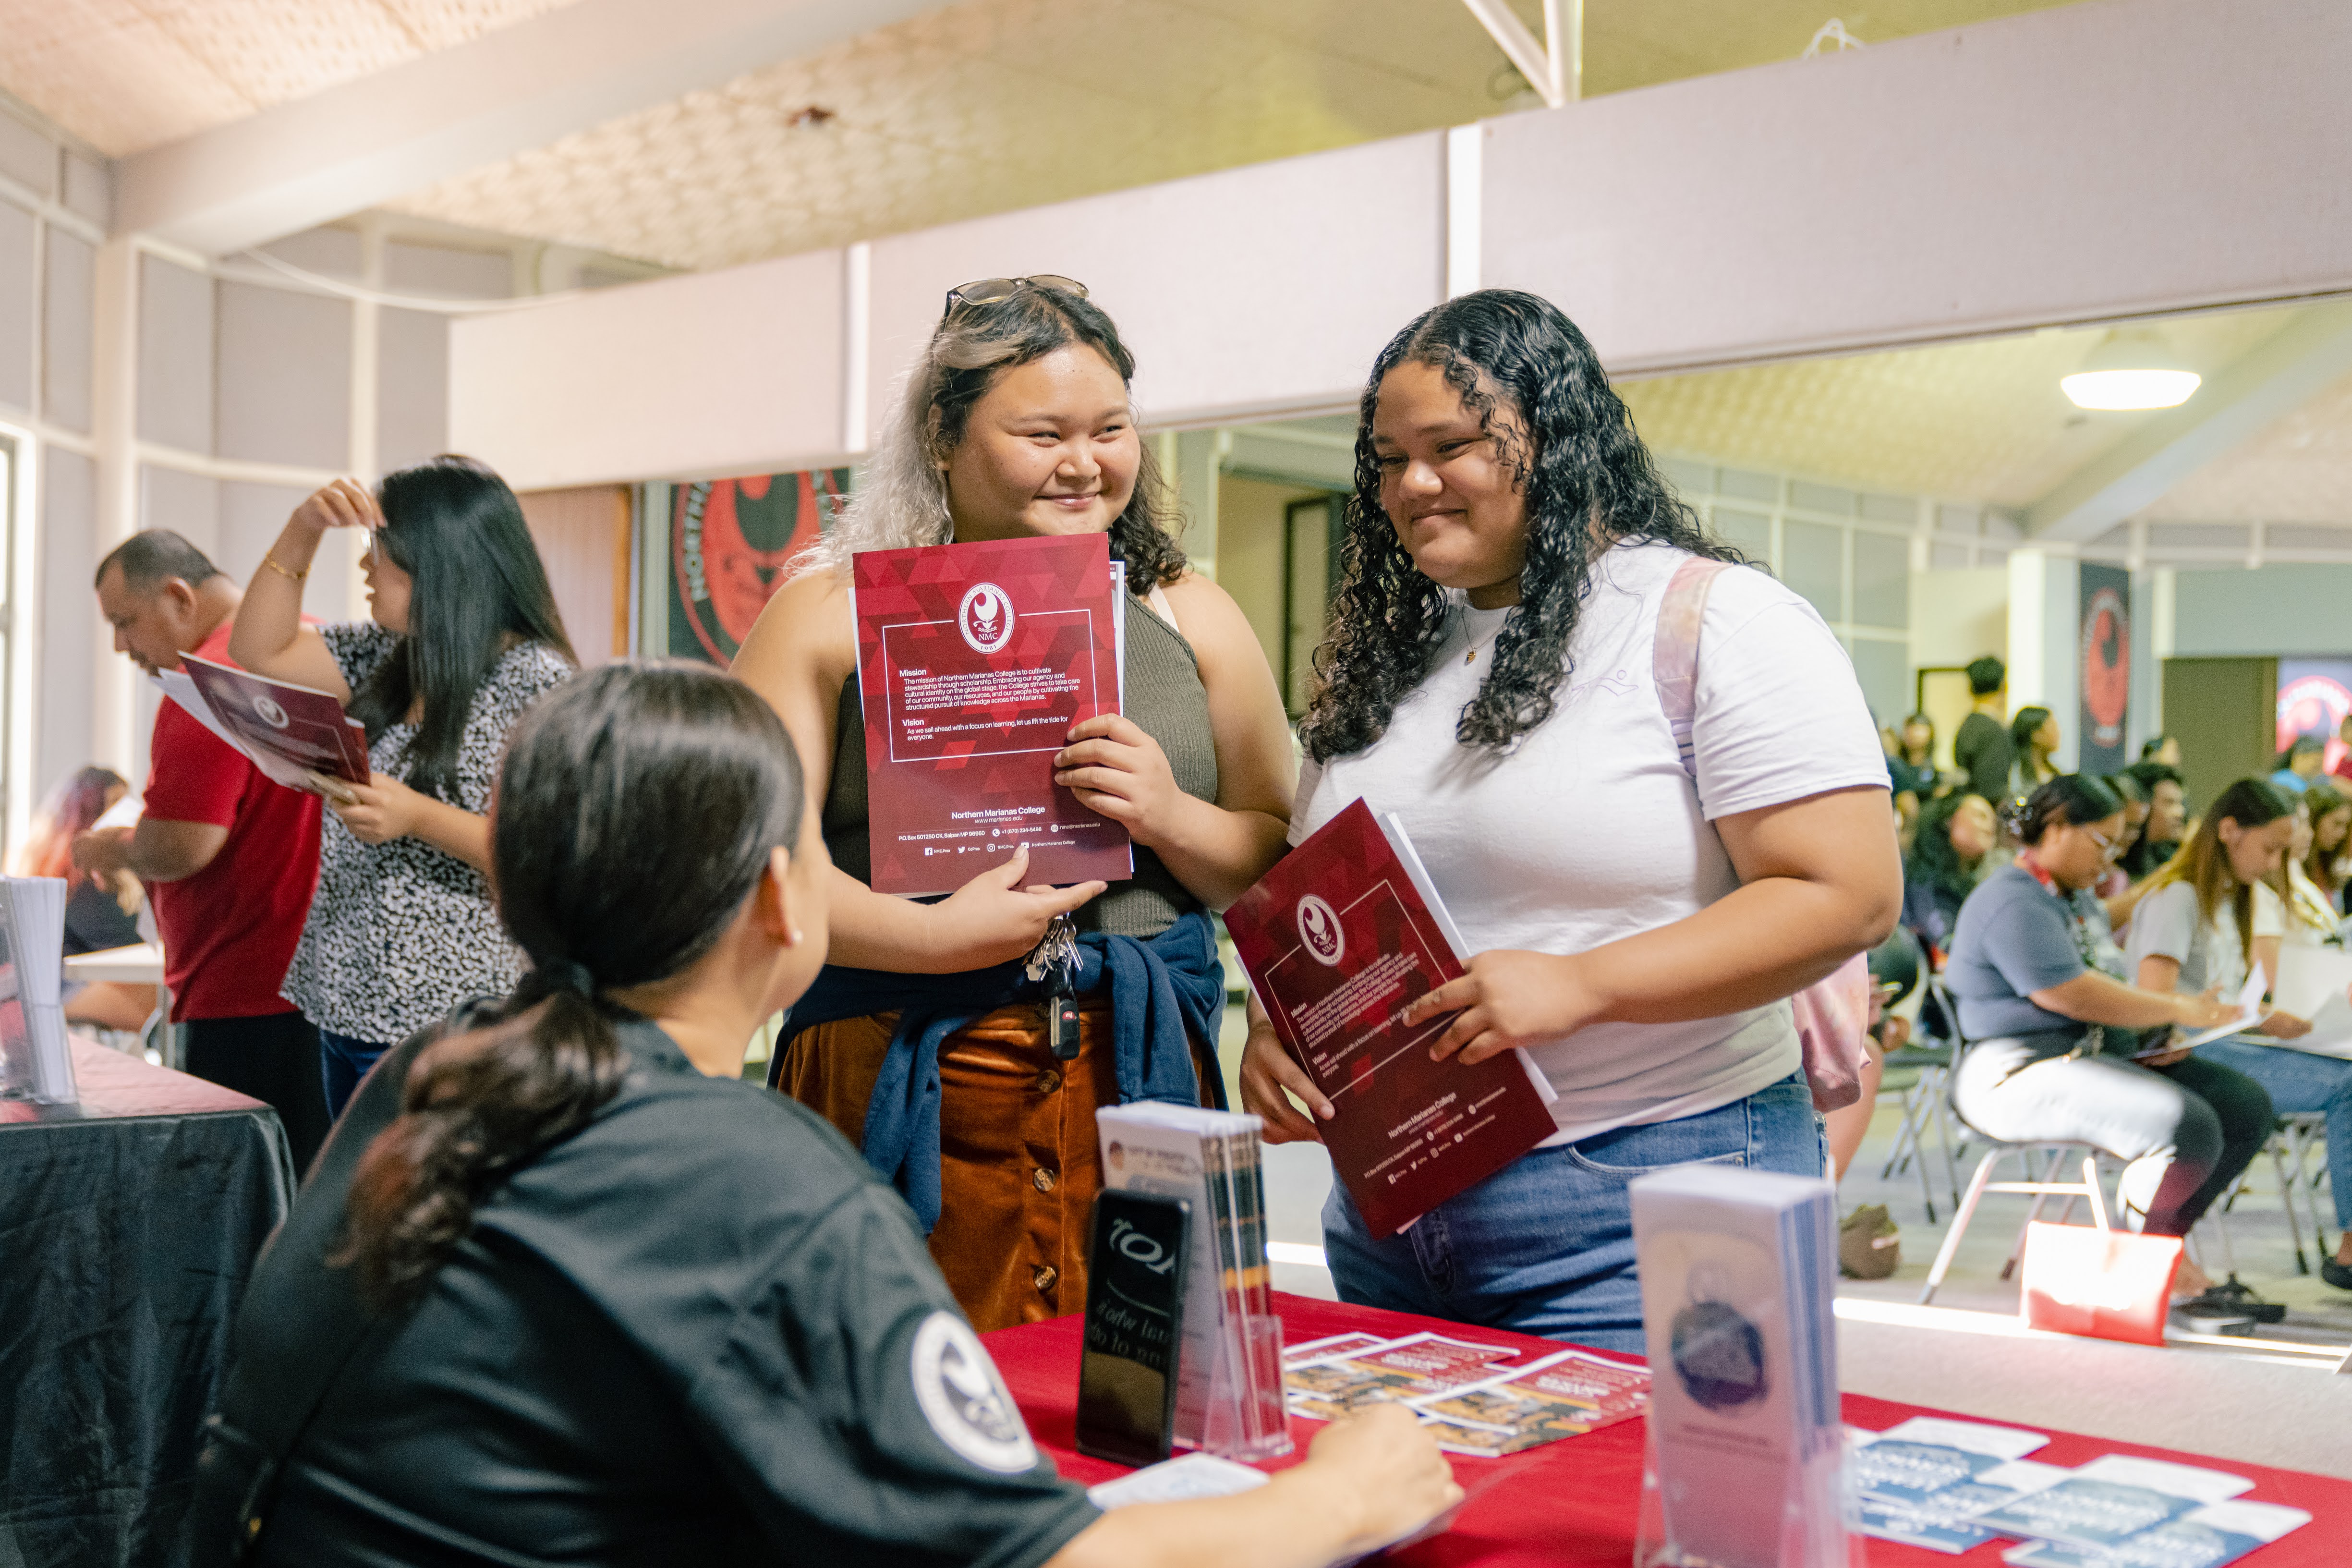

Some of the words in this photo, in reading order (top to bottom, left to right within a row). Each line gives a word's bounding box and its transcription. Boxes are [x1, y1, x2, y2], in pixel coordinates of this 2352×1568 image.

[962, 595, 972, 635] NORTHERN
[973, 585, 1006, 601] MARIANAS
[899, 669, 926, 677] Mission
[904, 682, 937, 691] stewardship
[938, 681, 959, 689] through
[960, 678, 992, 686] scholarship.
[993, 676, 1022, 684] Embracing
[964, 685, 981, 694] global
[921, 694, 953, 703] community,
[1013, 688, 1032, 697] people
[1040, 685, 1068, 693] cultivating
[906, 702, 934, 710] structured
[934, 701, 953, 710] pursuit
[960, 698, 990, 706] knowledge
[902, 718, 924, 727] Vision
[951, 811, 983, 819] Northern
[984, 808, 1017, 817] Marianas
[1018, 806, 1045, 814] College
[975, 815, 1023, 824] www.marianas.edu
[1321, 939, 1336, 955] NMC
[1290, 1002, 1308, 1018] Mission
[1312, 1052, 1327, 1065] Vision
[1388, 1119, 1413, 1139] Northern
[1410, 1105, 1437, 1124] Marianas
[1434, 1092, 1457, 1109] College
